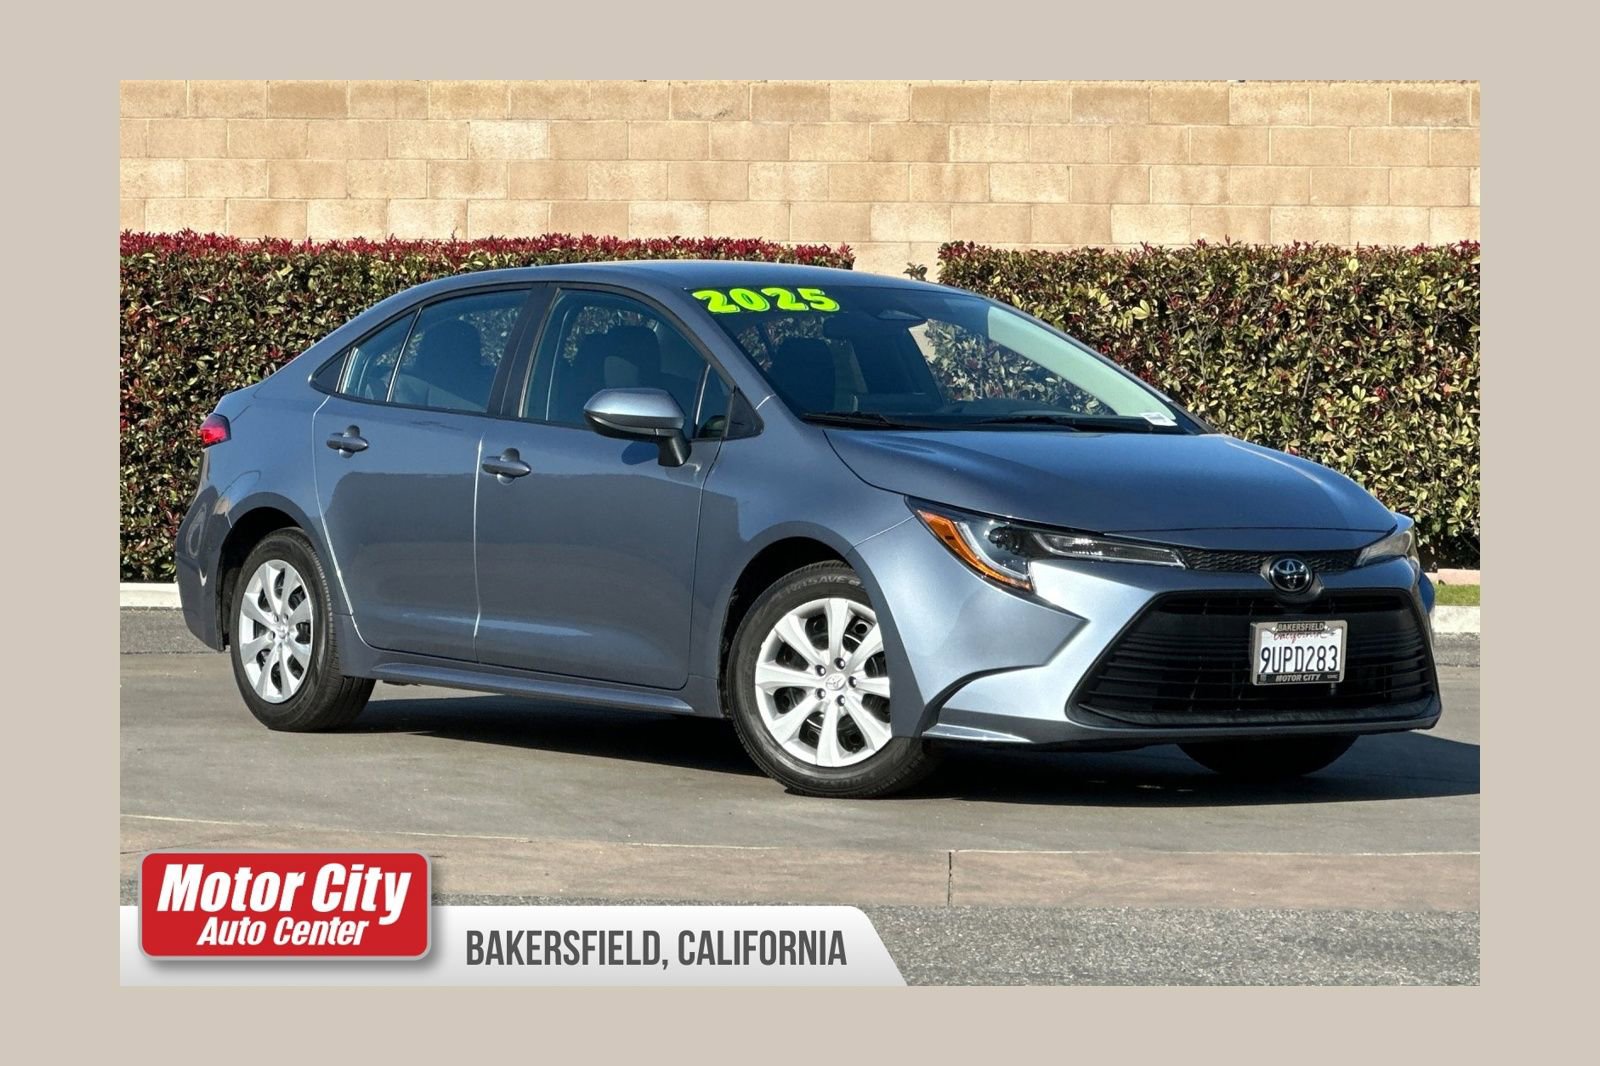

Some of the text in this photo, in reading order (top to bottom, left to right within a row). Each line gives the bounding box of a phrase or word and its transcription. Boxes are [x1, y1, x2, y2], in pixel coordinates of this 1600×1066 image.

[691, 287, 841, 314] 2025
[1278, 622, 1325, 632] BAKERSFIELD
[1260, 645, 1338, 674] 9UPD283
[1275, 674, 1302, 682] MOTOR
[1303, 673, 1321, 681] CITY
